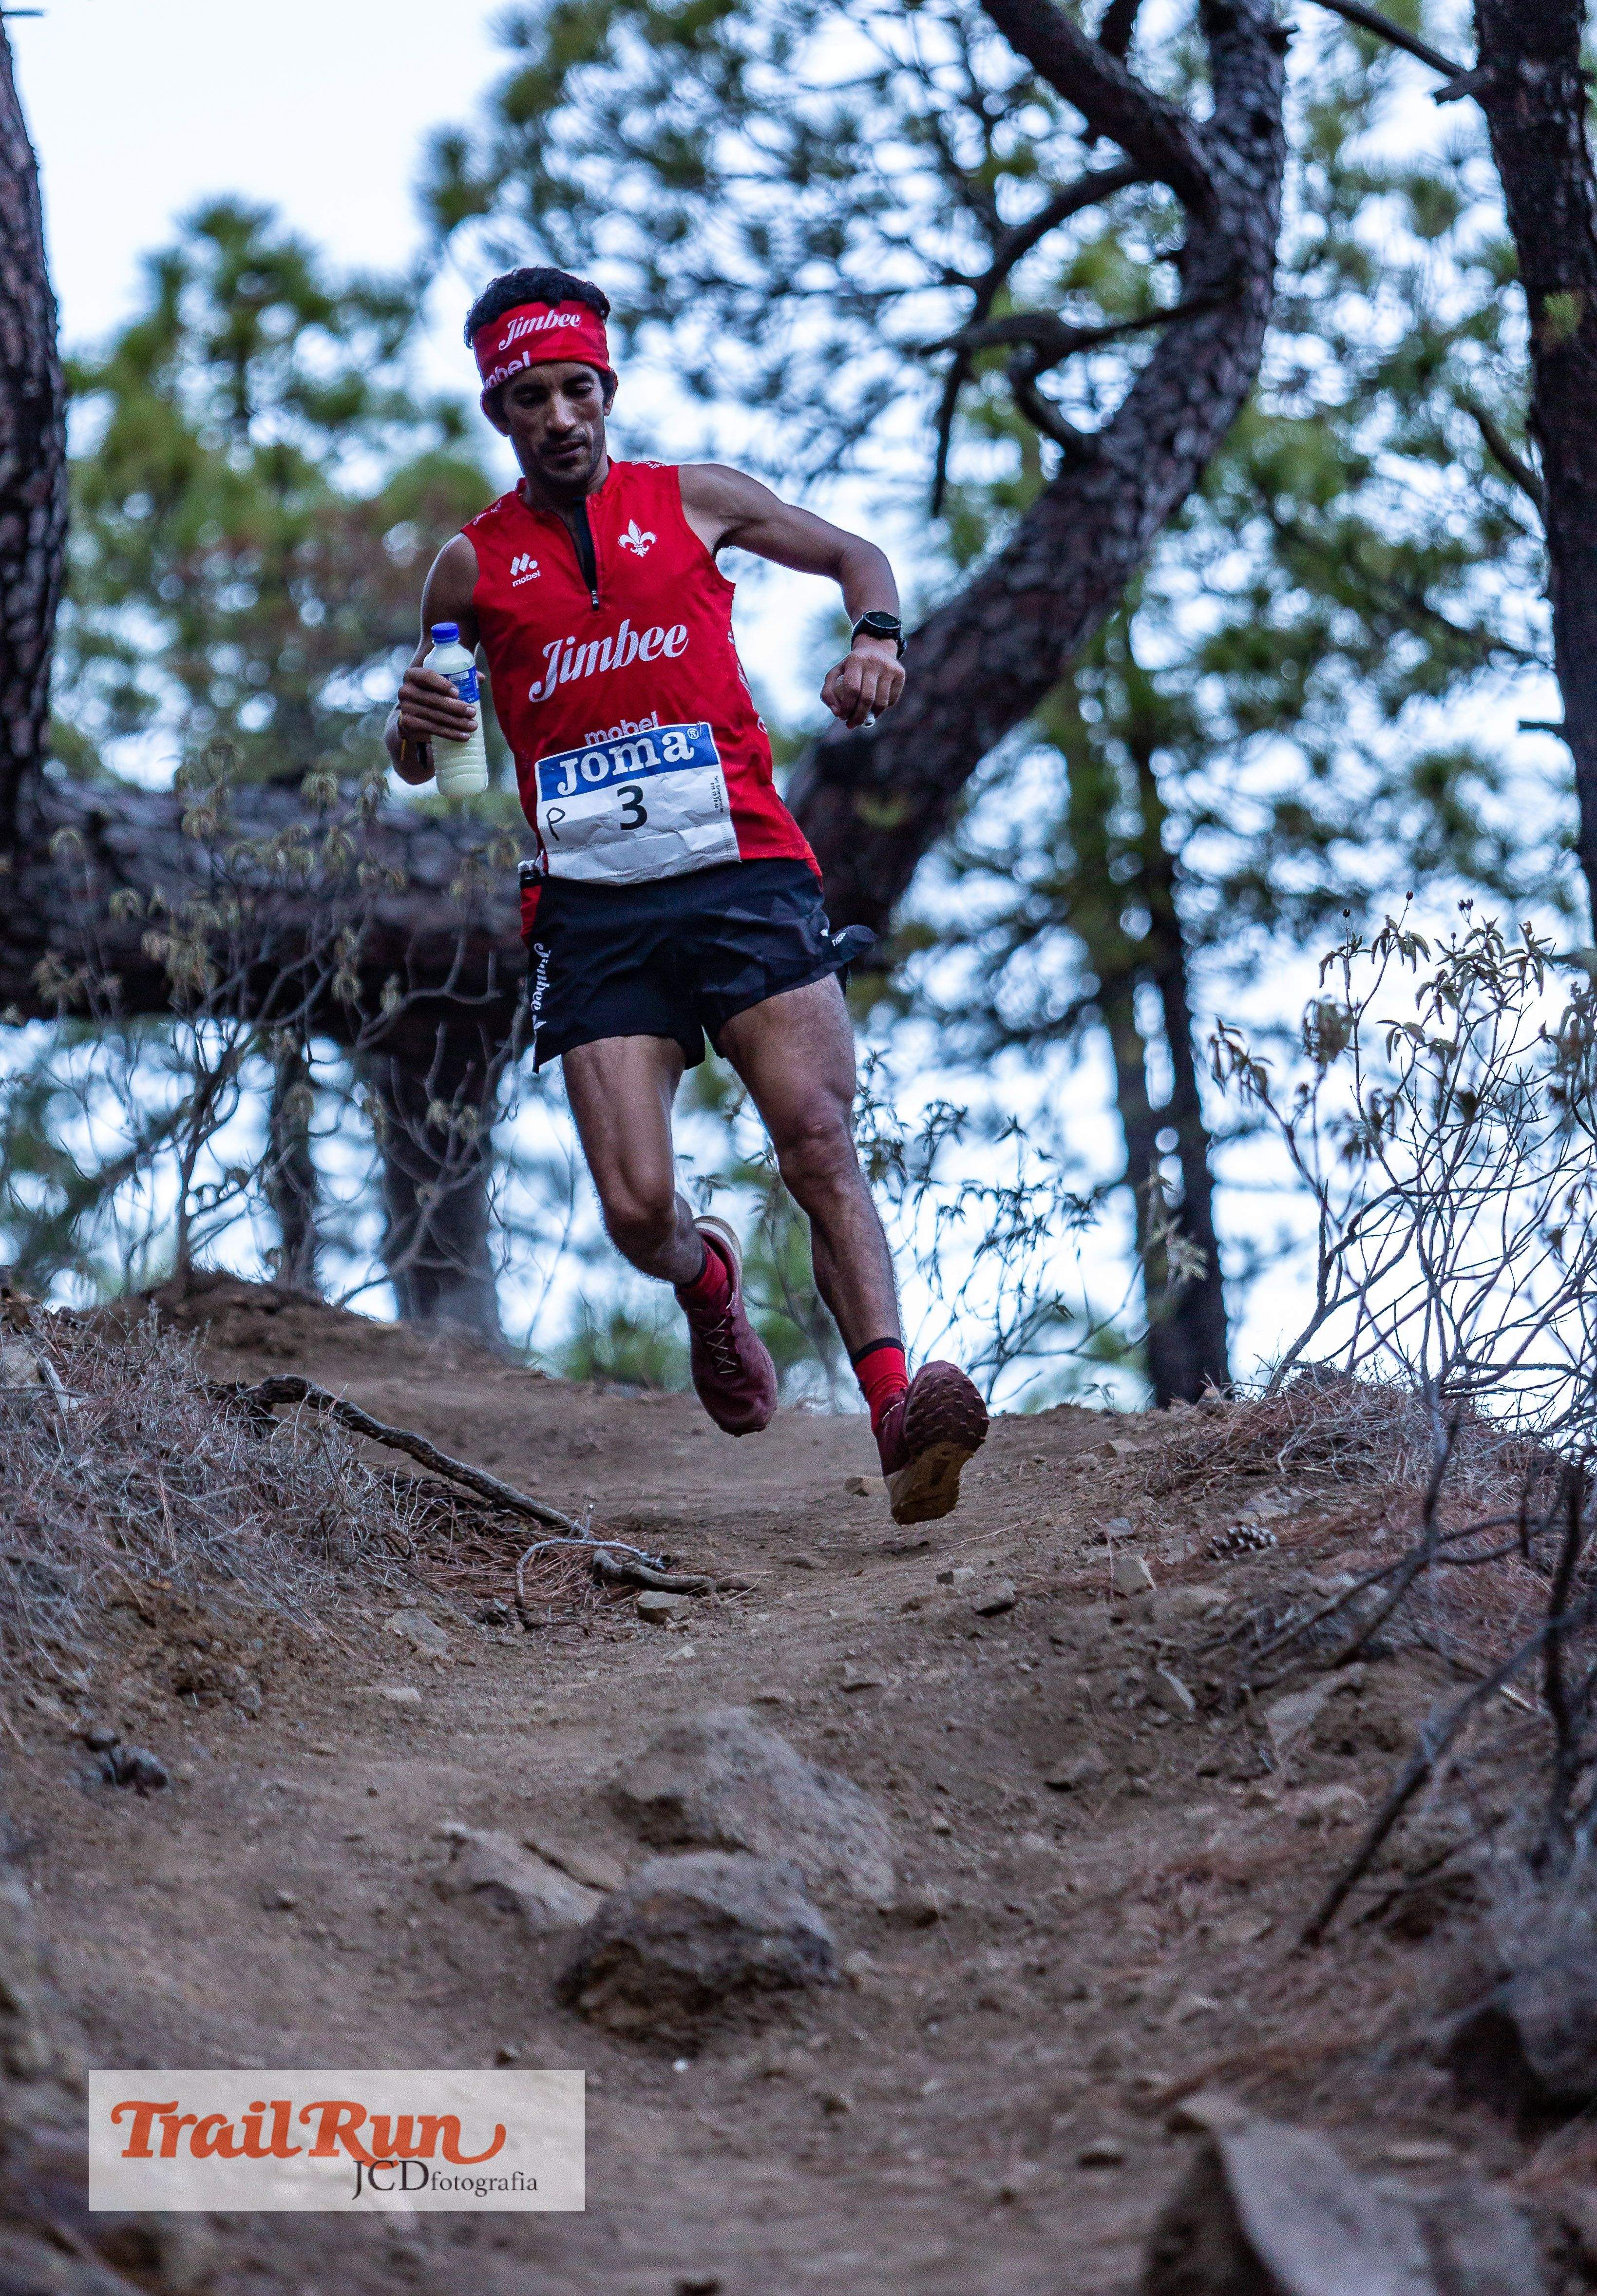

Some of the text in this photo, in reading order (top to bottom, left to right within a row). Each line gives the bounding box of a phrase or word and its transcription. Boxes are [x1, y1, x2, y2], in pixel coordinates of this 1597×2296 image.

[498, 309, 581, 351] Jimbee
[512, 570, 541, 587] mobel
[529, 619, 689, 703] Jimbee
[584, 711, 659, 746] mobel
[546, 807, 566, 842] P
[616, 785, 648, 831] 3
